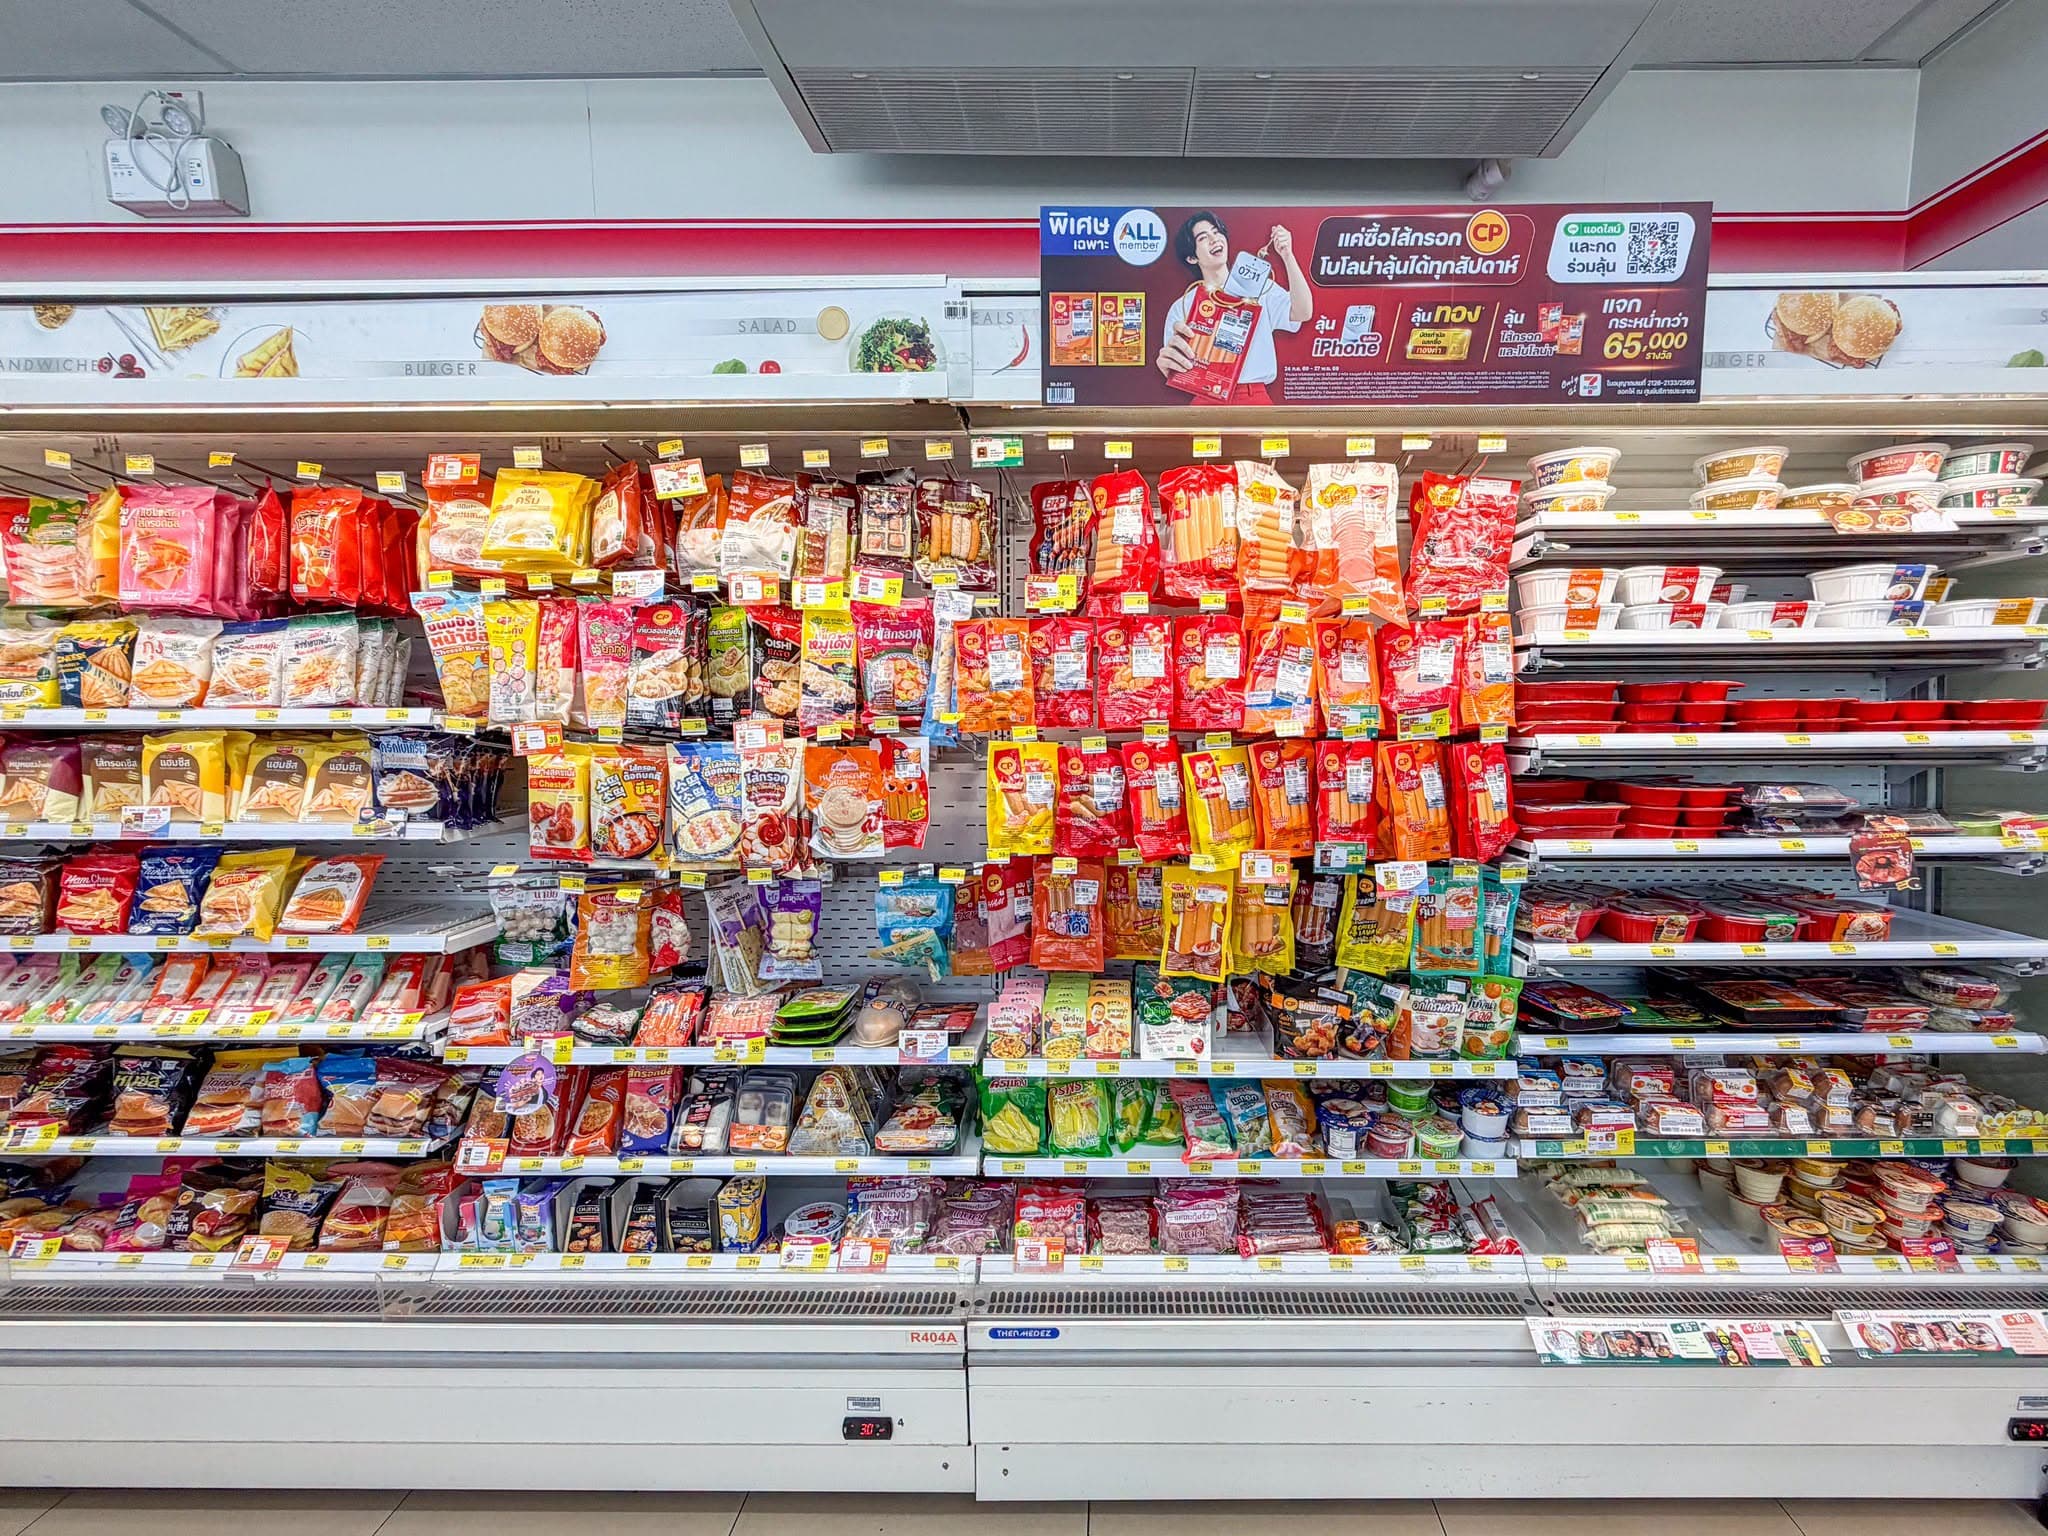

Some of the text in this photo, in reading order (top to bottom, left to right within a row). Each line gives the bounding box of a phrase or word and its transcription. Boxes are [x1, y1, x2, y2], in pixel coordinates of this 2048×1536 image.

[1048, 212, 1110, 236] พิเศษ
[1583, 222, 1622, 236] แอดไลน์
[1119, 222, 1161, 241] ALL
[1337, 222, 1462, 248] แค่ซื้อไส้กรอก
[1473, 223, 1504, 243] CP
[1073, 239, 1110, 251] เฉพาะ
[1119, 241, 1160, 250] member
[1569, 239, 1617, 254] และกด
[1237, 265, 1262, 284] 07:11
[1320, 254, 1520, 281] โบโลน่าลุ้นได้ทุกสัปดาห์
[1567, 257, 1617, 278] ร่วมลุ้น
[1602, 298, 1642, 313] แจก
[1411, 304, 1482, 324] ลุ้น ทอง
[1504, 310, 1524, 325] ลุ้น
[1608, 309, 1688, 329] กระหน่ำกว่า
[738, 319, 798, 333] SALAD
[1315, 315, 1335, 333] ลุ้น
[1500, 331, 1542, 343] ไส้กรอก
[1313, 337, 1379, 357] iPhone
[1498, 344, 1555, 358] และโบโลน่า
[1603, 331, 1688, 359] 65,000
[1645, 349, 1673, 360] รางวัล
[405, 363, 477, 376] BURGER
[654, 612, 672, 621] CP
[764, 637, 792, 650] OISHI
[1108, 633, 1121, 642] CP
[1185, 635, 1198, 643] CP
[160, 758, 191, 769] แฮมชีส
[266, 760, 298, 771] แฮมชีส
[329, 762, 362, 773] แฮมชีส
[64, 874, 91, 885] Ham
[751, 1045, 760, 1053] 35
[911, 1331, 958, 1343] R404A
[897, 1418, 904, 1427] 4
